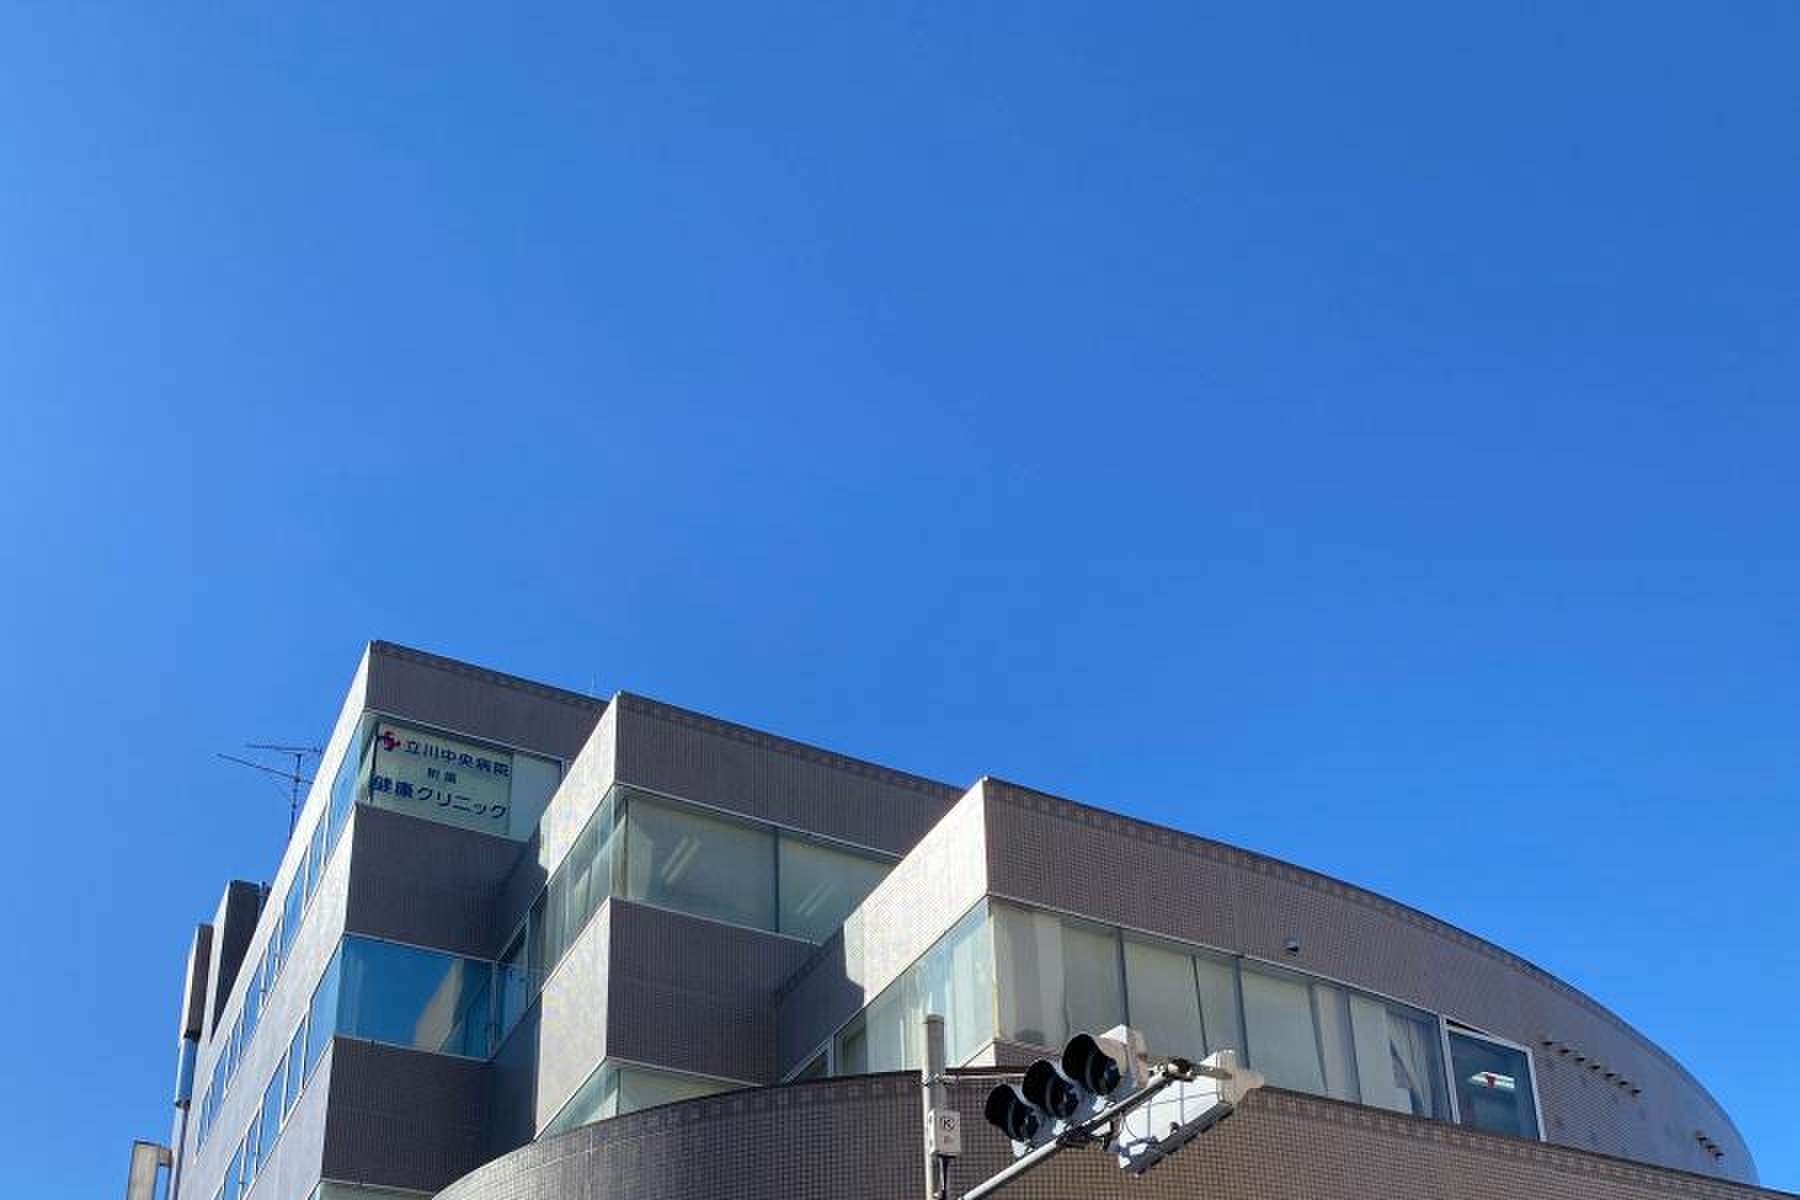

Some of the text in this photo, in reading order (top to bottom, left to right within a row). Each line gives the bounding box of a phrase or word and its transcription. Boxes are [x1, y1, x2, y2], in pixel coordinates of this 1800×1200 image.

[404, 741, 512, 777] 立川中央病院
[369, 774, 507, 818] 健康クリニック
